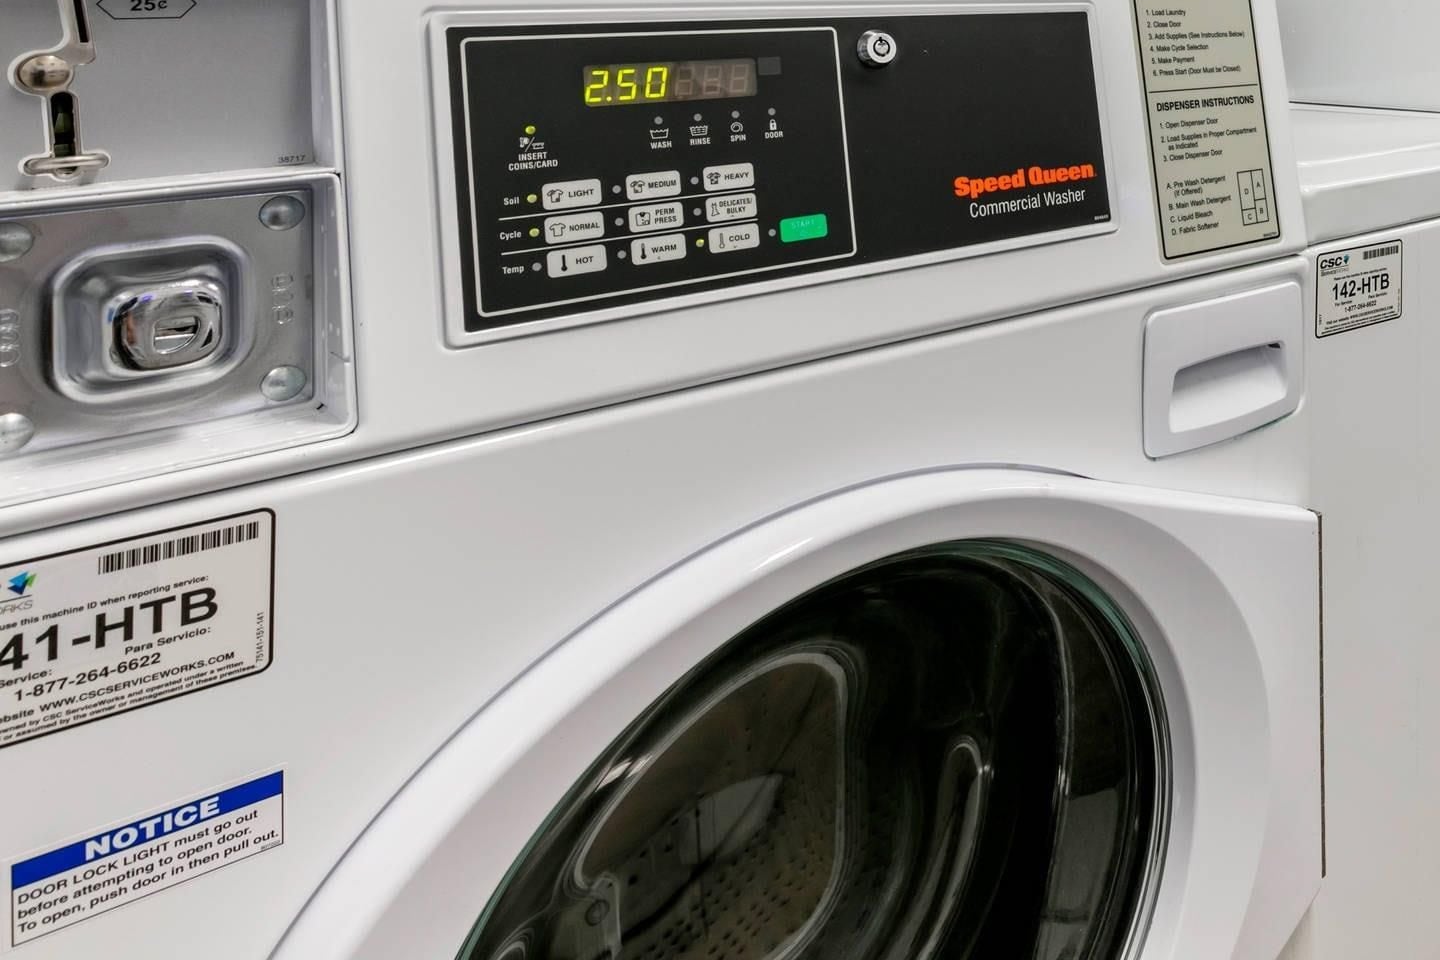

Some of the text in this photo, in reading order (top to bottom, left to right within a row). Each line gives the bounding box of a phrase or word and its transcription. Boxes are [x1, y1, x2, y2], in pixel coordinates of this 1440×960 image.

[1166, 9, 1186, 17] Laundry
[1154, 30, 1245, 41] Add Supplies (See Instructions Below)
[1171, 44, 1186, 53] Cycle
[1173, 56, 1195, 64] Payment
[1188, 67, 1202, 76] (Door
[1222, 65, 1241, 73] Closed)
[585, 66, 668, 103] 2.50
[1156, 95, 1255, 112] DISPENSER INSTRUCTIONS
[1165, 121, 1180, 130] Open
[1180, 118, 1205, 128] Dispenser
[730, 134, 746, 142] SPIN
[764, 131, 783, 139] DOOR
[1166, 134, 1180, 142] Load
[1181, 132, 1202, 142] Supplies
[1208, 130, 1224, 138] Proper
[1225, 126, 1257, 137] Compartment
[650, 140, 672, 150] WASH
[689, 137, 711, 146] RINSE
[1175, 141, 1199, 150] Indicated
[277, 155, 306, 164] 38717
[518, 151, 548, 161] INSERT
[1169, 149, 1223, 162] Close Dispenser Door
[508, 159, 558, 172] COINS/CARD
[724, 172, 749, 180] HEAVY
[954, 163, 1094, 199] Speed Queen
[648, 180, 677, 189] MEDIUM
[1174, 181, 1184, 189] Pre
[1184, 179, 1200, 187] Wash
[1200, 175, 1226, 185] Detergent
[568, 189, 594, 198] LIGHT
[1181, 187, 1203, 197] Offered)
[503, 196, 520, 206] Soil
[719, 198, 753, 207] DELICATES/
[969, 189, 1086, 218] Commercial Washer
[1175, 195, 1232, 210] Main Wash Detergent
[655, 207, 675, 216] PERM
[726, 206, 746, 214] BULKY
[654, 215, 677, 224] PRESS
[1177, 210, 1213, 223] Liquid Bleach
[569, 222, 600, 232] NORMAL
[791, 220, 815, 230] START
[1179, 222, 1219, 234] Fabric Softener
[499, 230, 522, 241] Cycle
[729, 233, 750, 242] COLD
[651, 244, 677, 253] WARM
[575, 256, 594, 265] HOT
[1320, 256, 1343, 269] CSC
[502, 265, 524, 275] Temp
[1332, 273, 1390, 300] 142-HTB
[20, 616, 39, 626] this
[42, 605, 85, 621] machine
[87, 601, 98, 610] ID
[100, 595, 126, 608] when
[128, 584, 171, 600] reporting
[173, 575, 209, 589] service:
[0, 587, 218, 672] 41-HTB
[125, 642, 154, 655] Para
[157, 626, 212, 647] Servicio:
[14, 652, 162, 702] 1-877-264-6622
[39, 651, 235, 713] WWW.CSCSERVICEWORKS.COM
[85, 796, 220, 861] NOTICE
[18, 810, 259, 905] DOOR LOCK LIGHT must go out
[17, 895, 68, 920] before
[72, 864, 154, 899] attempting
[158, 856, 173, 867] to
[177, 841, 213, 860] open
[217, 826, 252, 845] door.
[17, 921, 37, 933] To
[41, 904, 86, 924] open,
[89, 887, 128, 909] push
[132, 871, 167, 890] door
[171, 866, 184, 876] in
[188, 852, 220, 870] then
[223, 839, 249, 858] pull
[253, 830, 279, 845] out.
